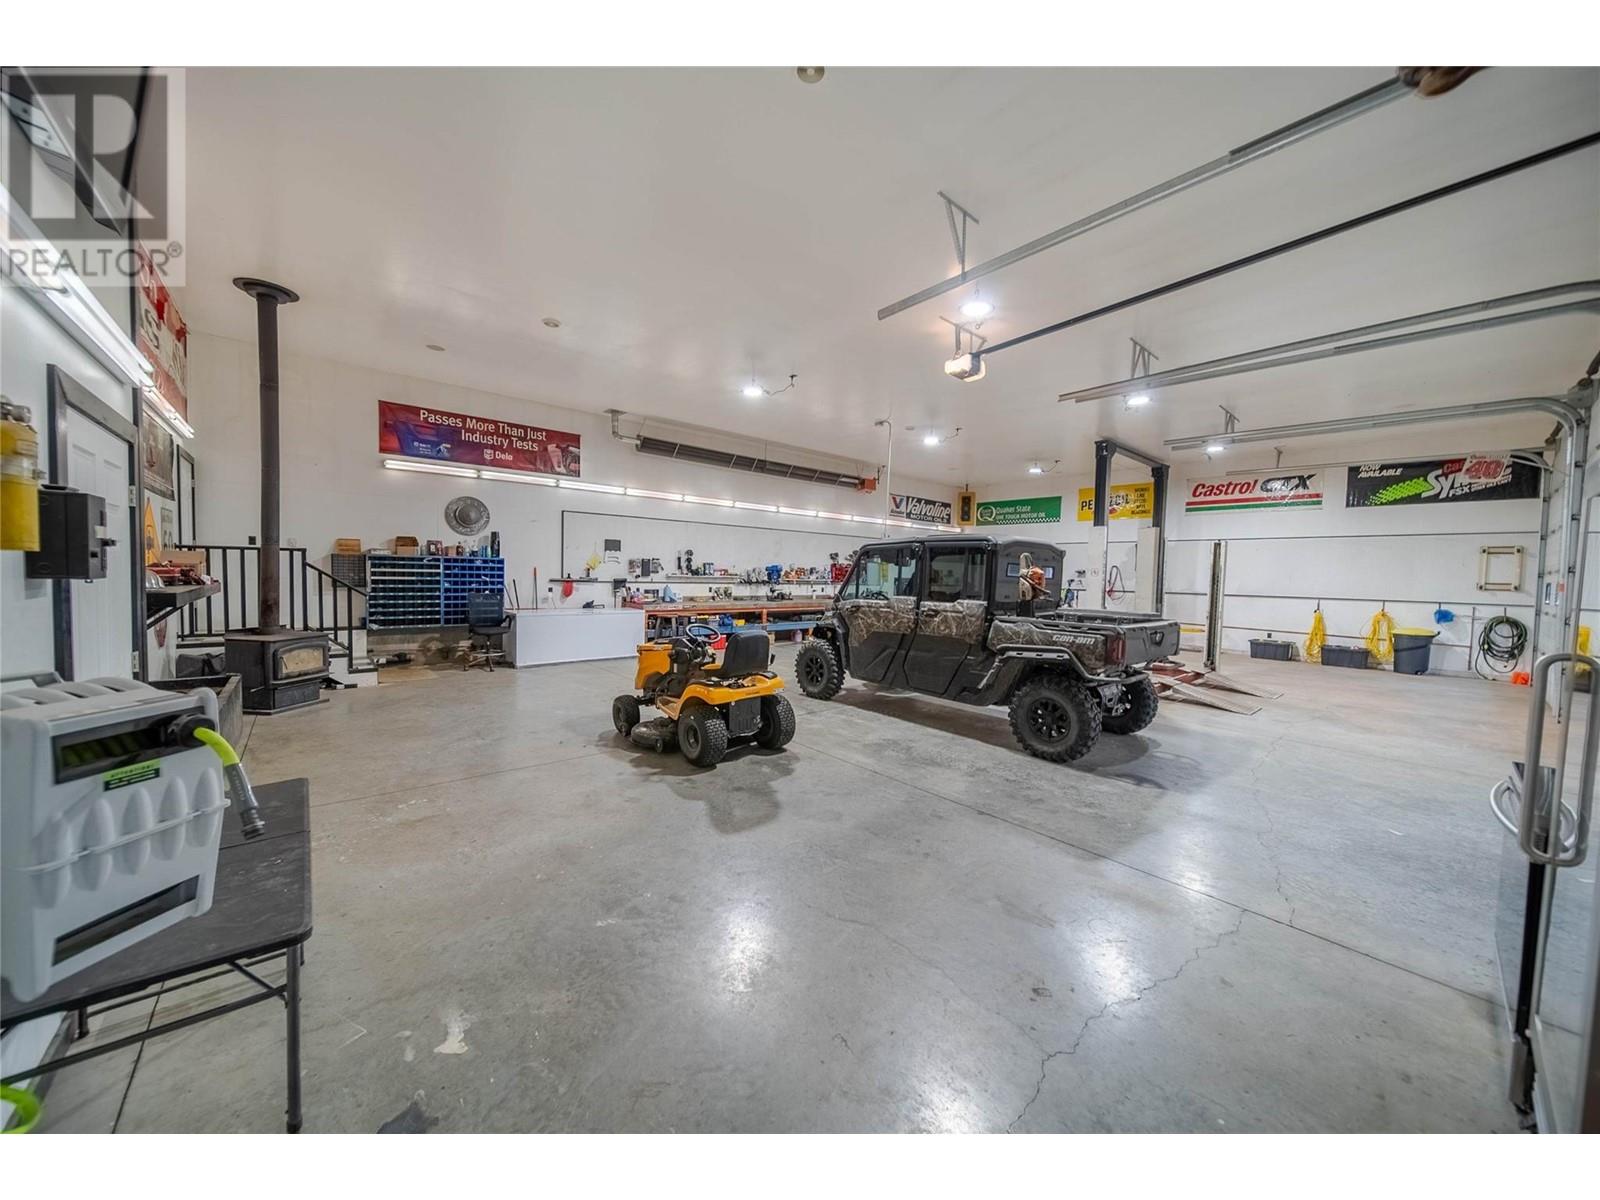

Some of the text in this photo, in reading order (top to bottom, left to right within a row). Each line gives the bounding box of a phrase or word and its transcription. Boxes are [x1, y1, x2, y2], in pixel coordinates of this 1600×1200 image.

[420, 409, 546, 440] Passes More Than Just
[461, 429, 538, 451] Industry Tests
[1358, 468, 1403, 478] AVAILABLE
[1192, 474, 1317, 497] Castrol GTX
[906, 497, 951, 518] Valvoline
